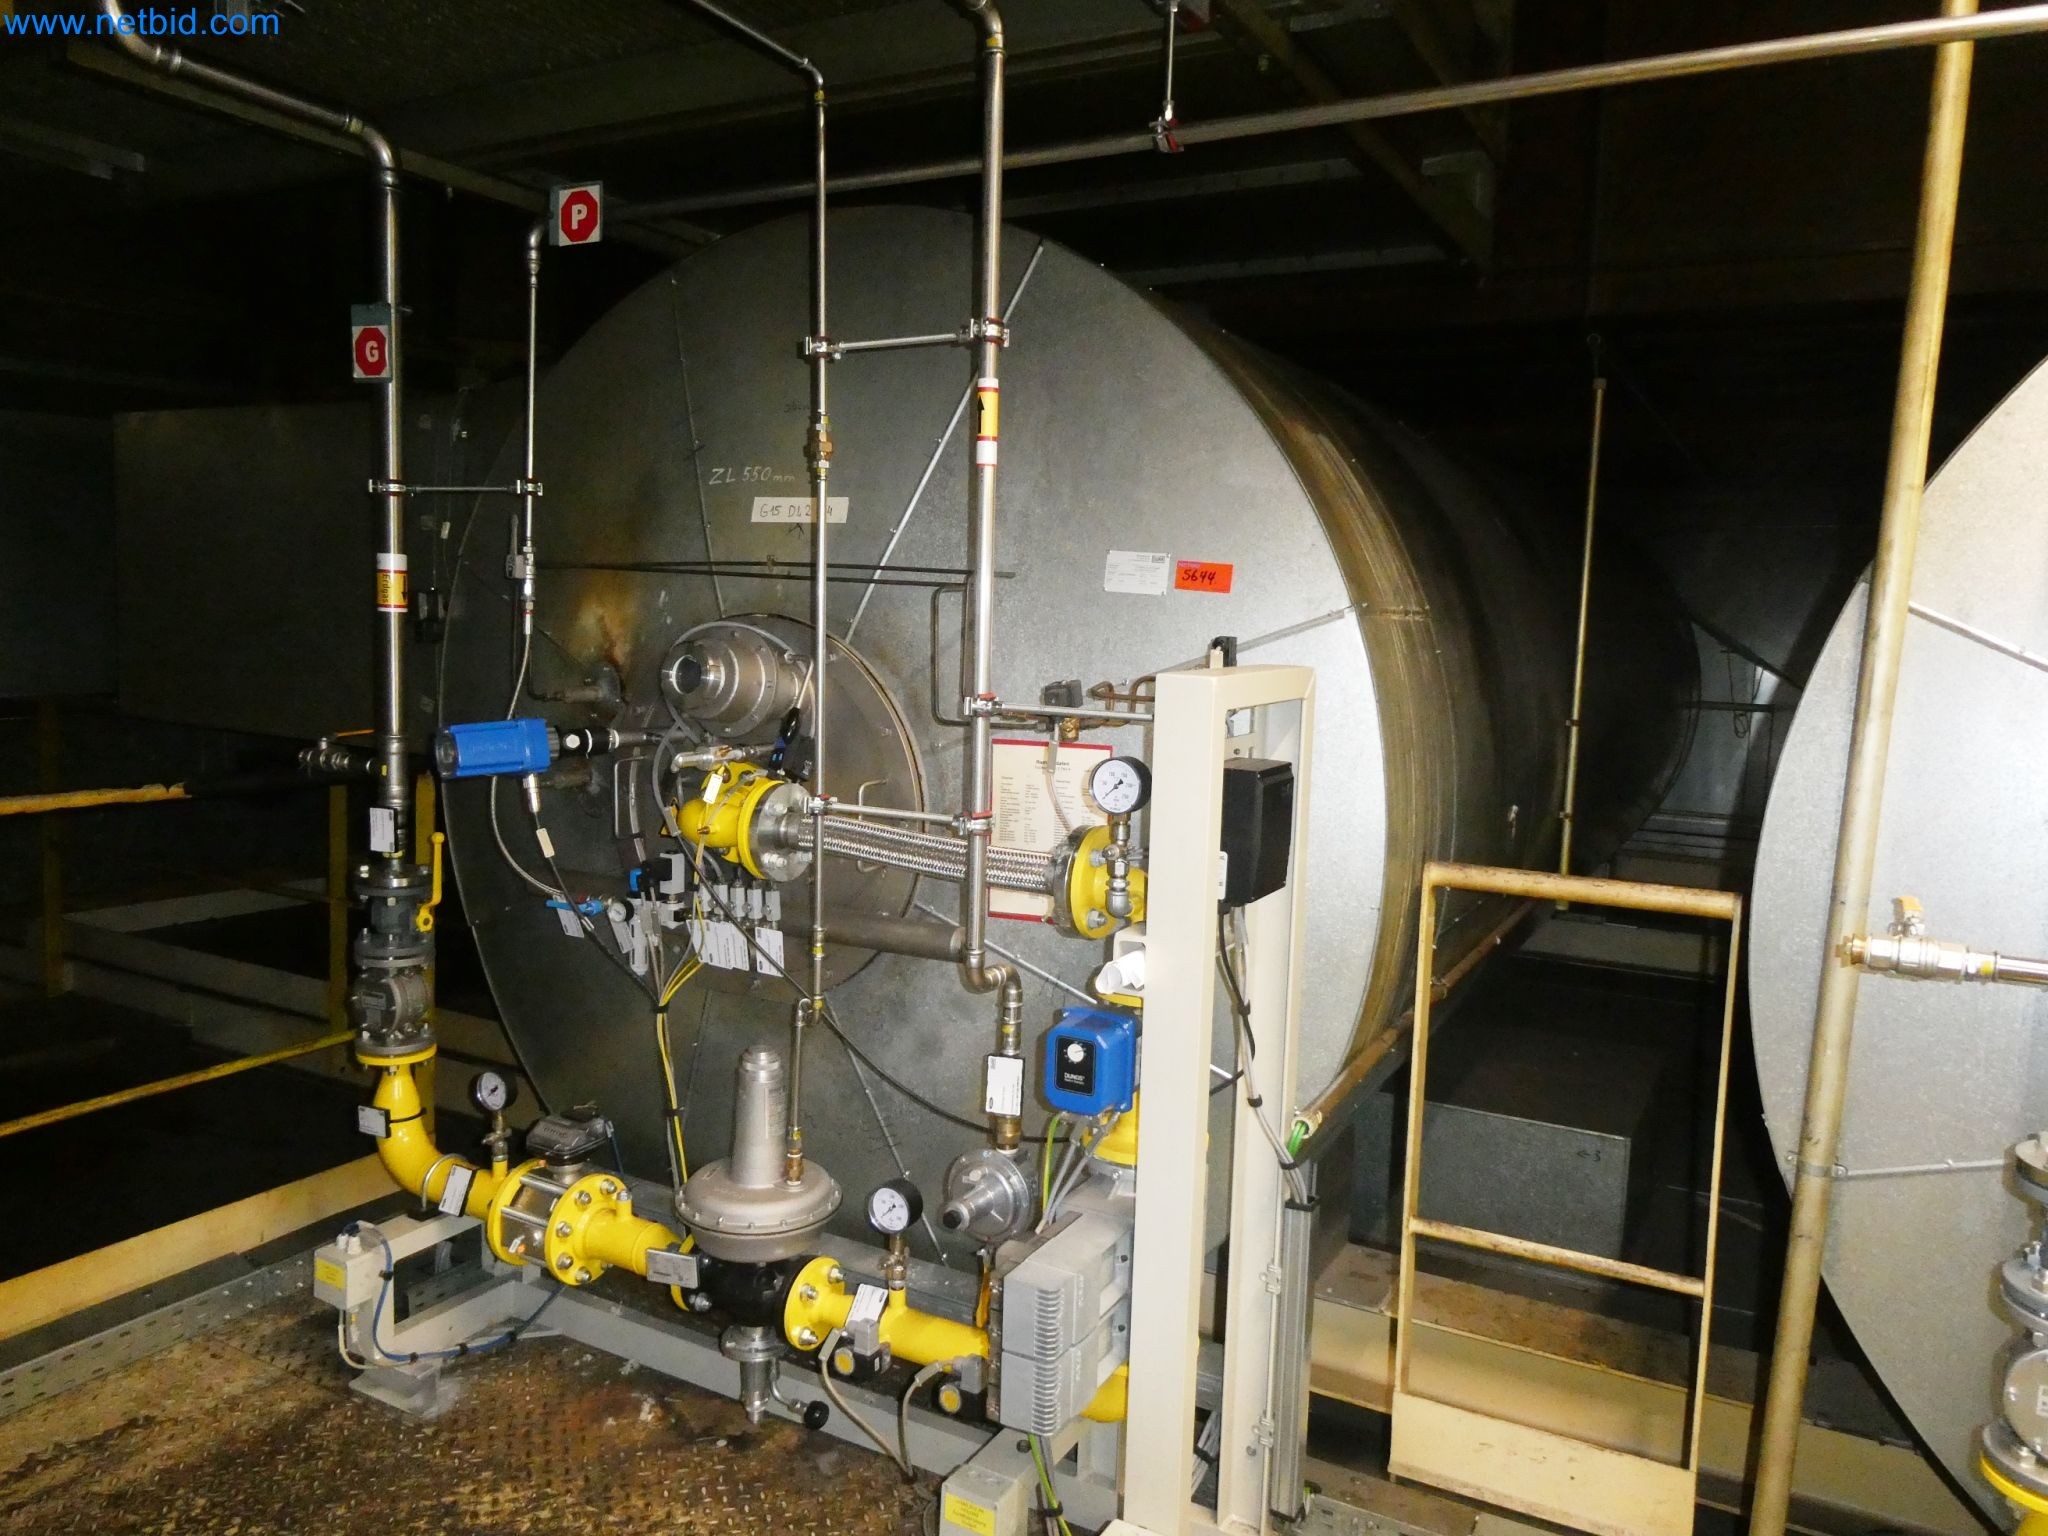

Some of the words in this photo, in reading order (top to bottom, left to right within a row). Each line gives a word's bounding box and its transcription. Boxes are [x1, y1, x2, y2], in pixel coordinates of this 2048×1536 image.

[571, 204, 588, 230] P
[365, 340, 379, 363] G
[382, 573, 392, 603] Erdgas
[1182, 569, 1217, 586] 5644
